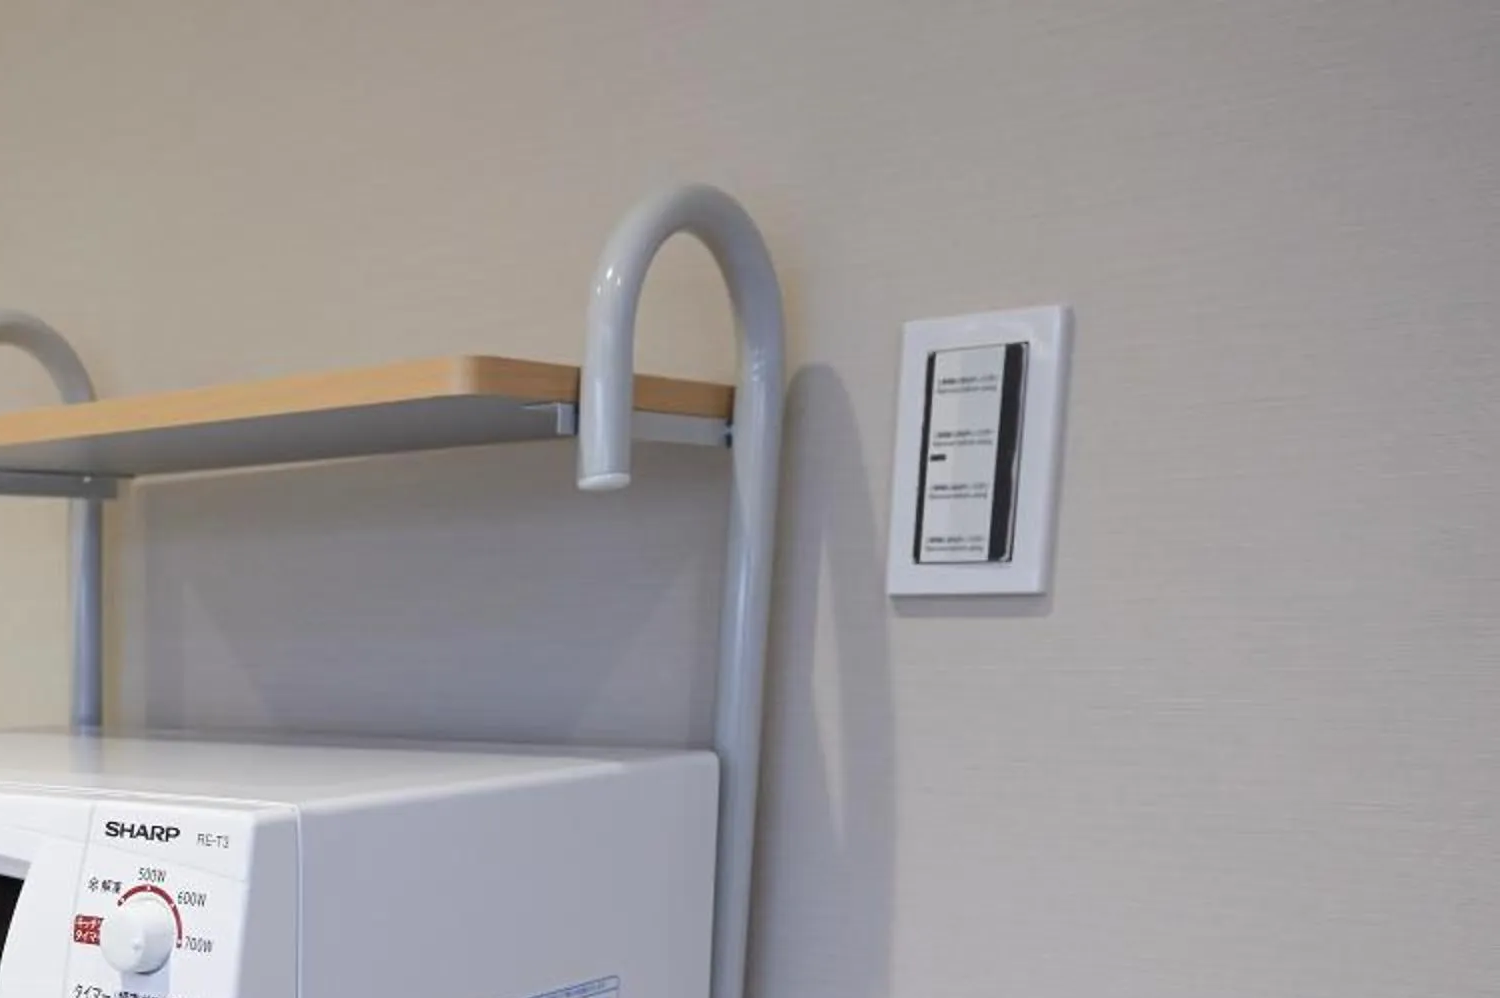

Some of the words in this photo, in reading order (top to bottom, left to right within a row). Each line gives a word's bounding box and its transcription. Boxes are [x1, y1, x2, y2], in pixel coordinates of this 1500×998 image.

[104, 820, 181, 843] SHARP
[138, 867, 166, 883] 500W
[177, 891, 207, 907] 600W
[184, 935, 213, 953] 700W
